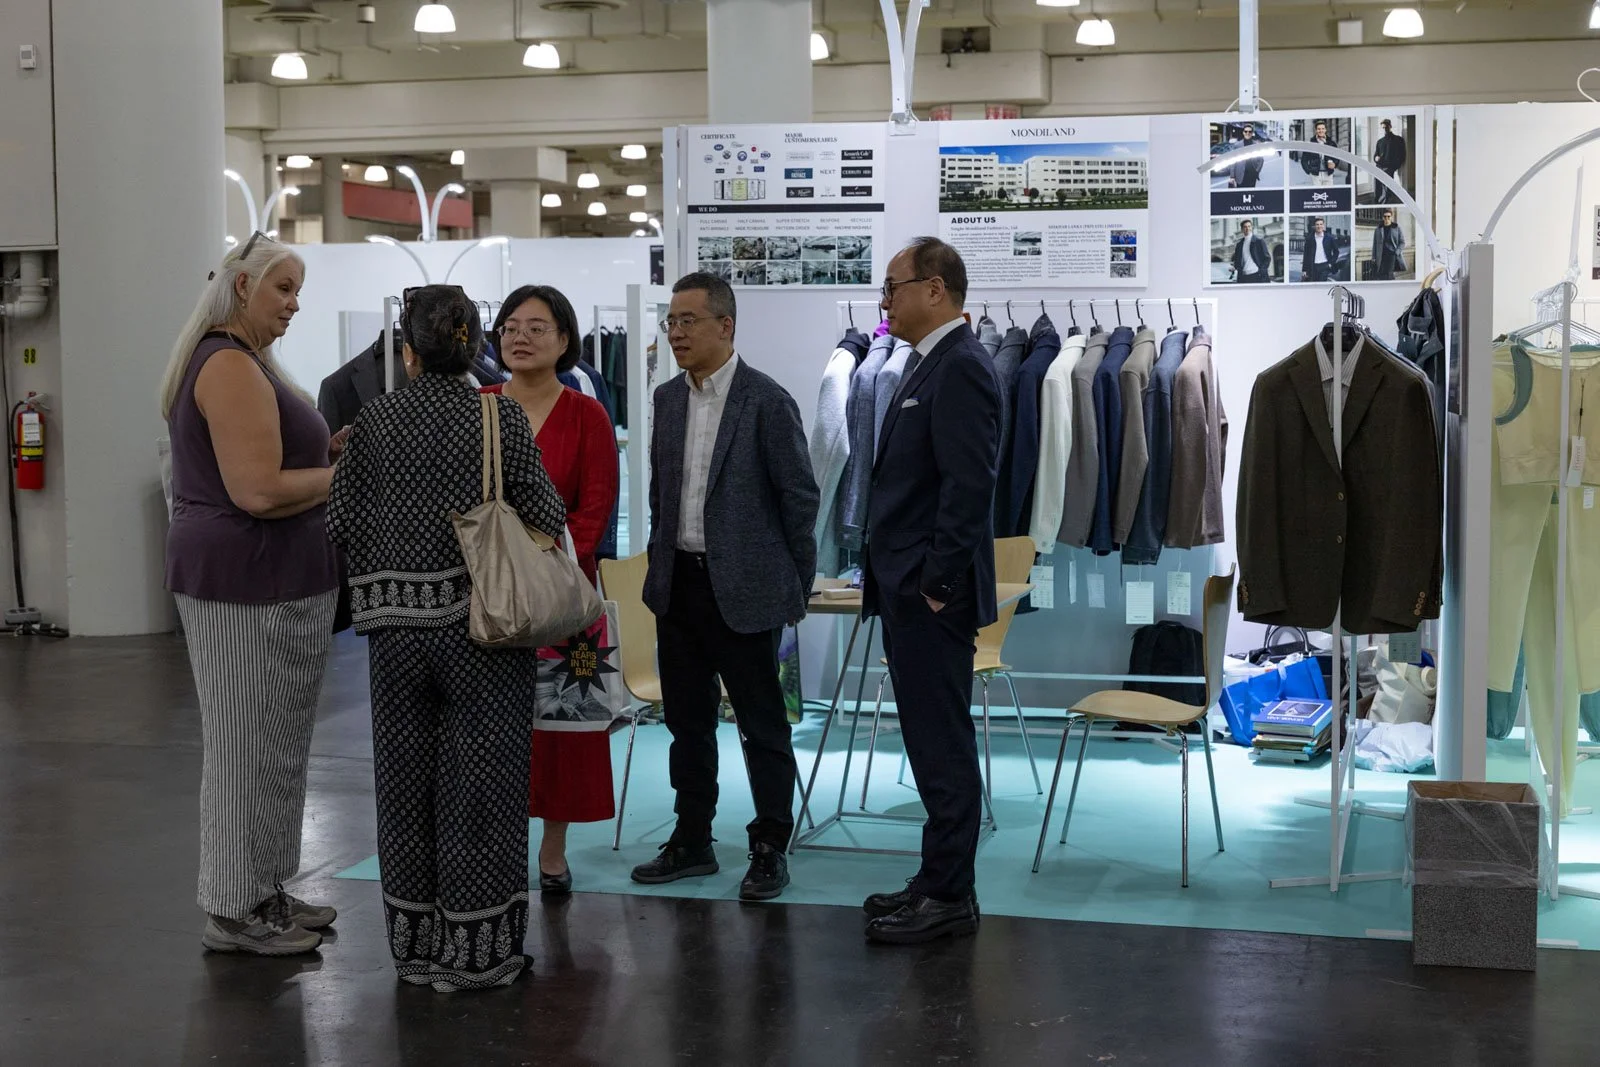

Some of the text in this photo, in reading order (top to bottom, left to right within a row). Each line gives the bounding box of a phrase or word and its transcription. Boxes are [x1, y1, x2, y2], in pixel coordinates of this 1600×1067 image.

[1011, 127, 1076, 137] MONDILAND
[578, 642, 588, 651] 20
[570, 651, 597, 660] YEARS
[570, 660, 597, 669] IN THE
[575, 668, 593, 677] BAG
